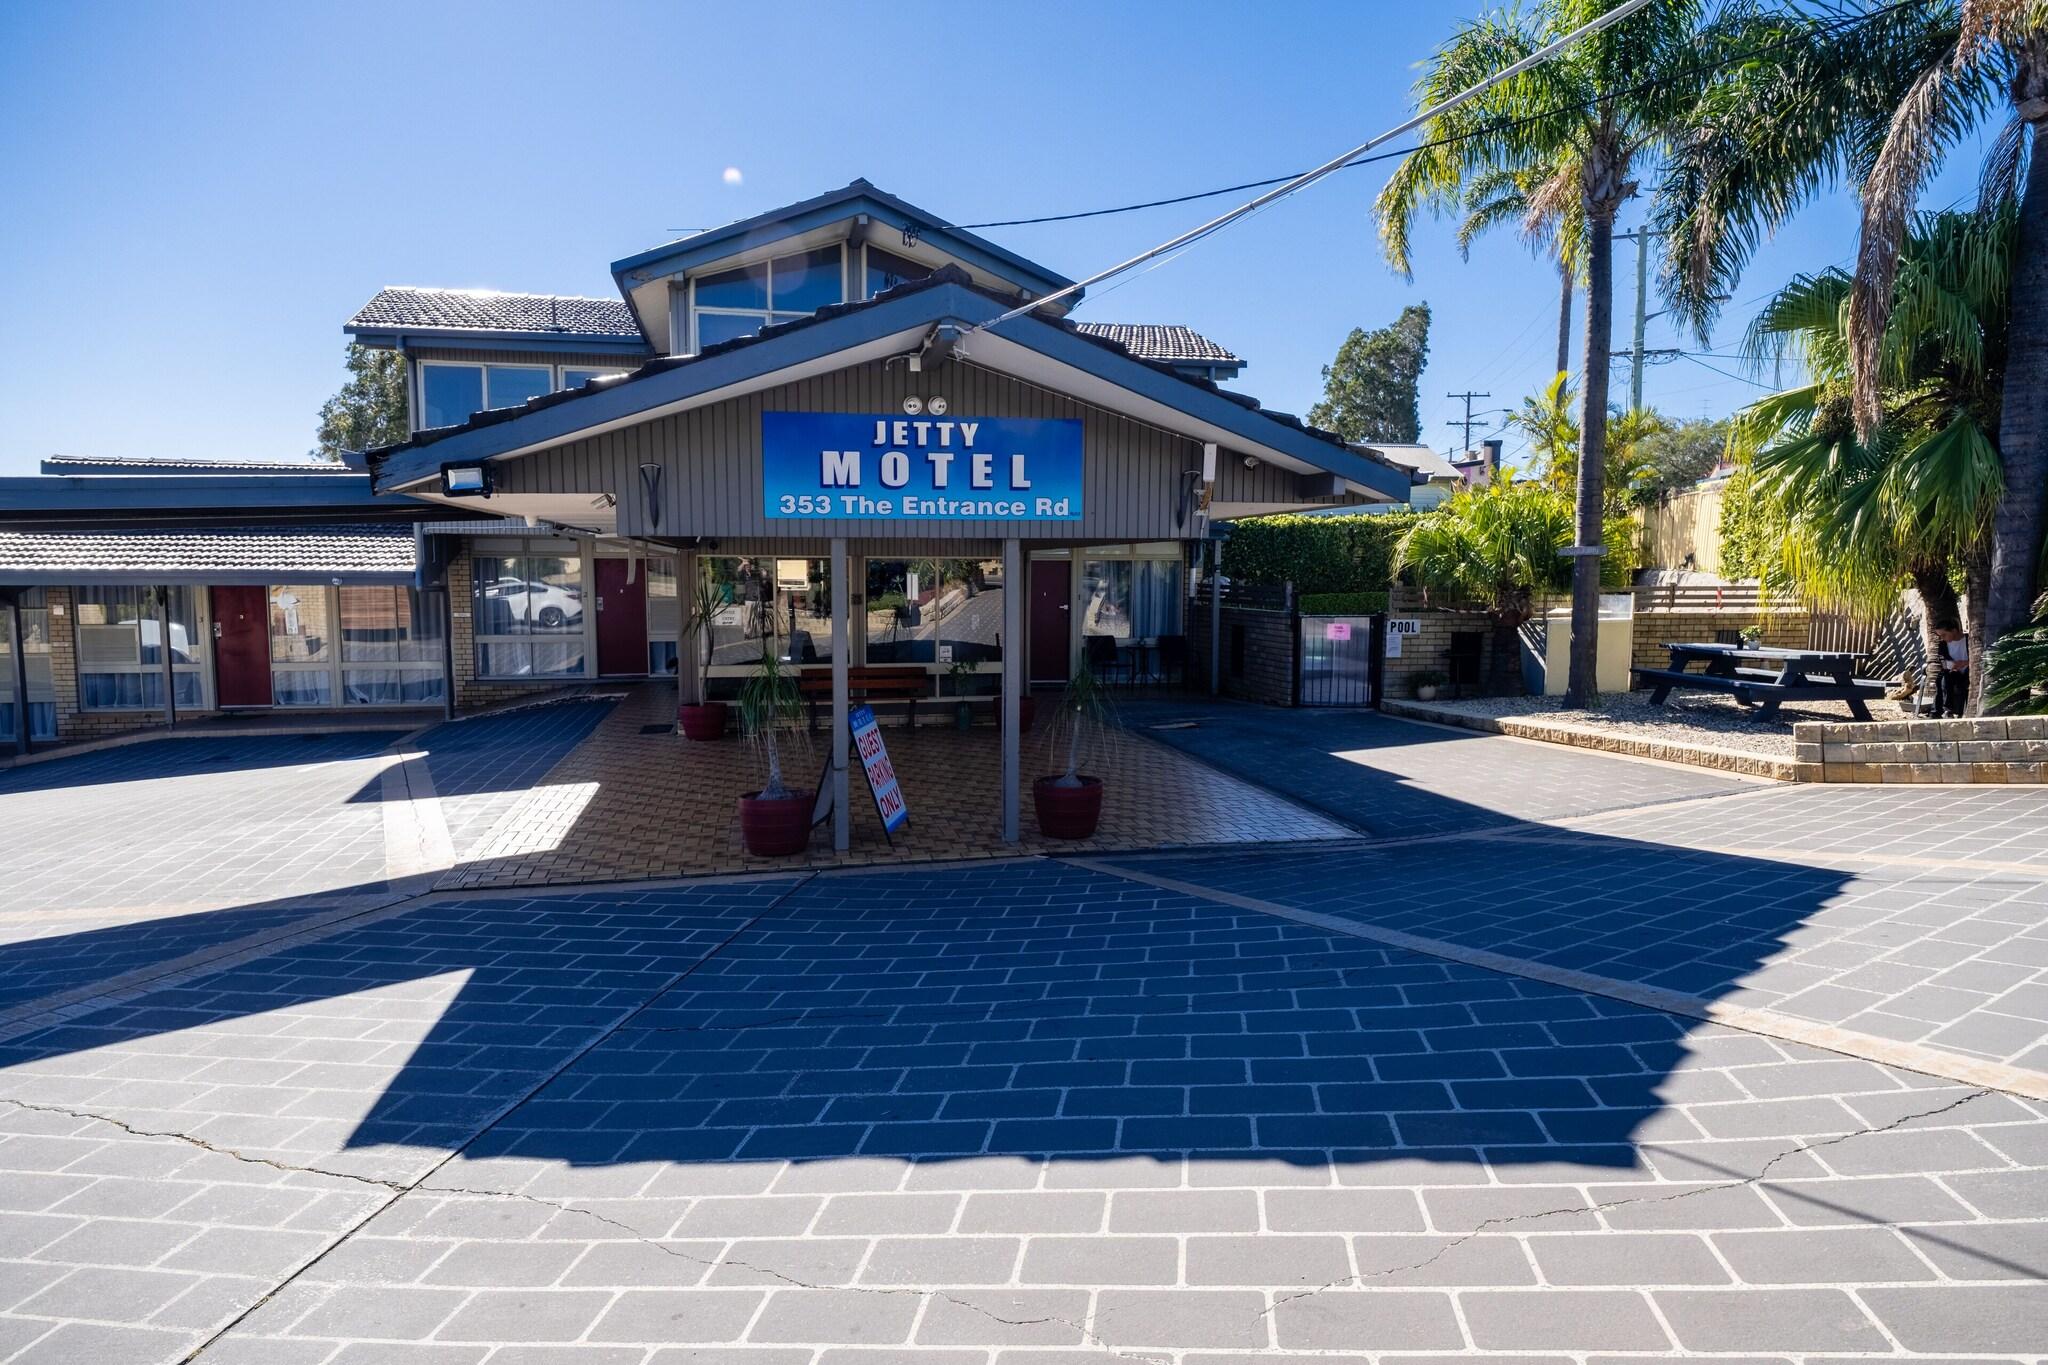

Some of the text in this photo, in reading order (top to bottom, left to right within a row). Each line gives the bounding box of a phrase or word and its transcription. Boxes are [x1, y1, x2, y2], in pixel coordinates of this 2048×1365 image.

[873, 420, 979, 447] JETTY
[821, 450, 1031, 489] MOTEL
[779, 495, 1070, 516] 353 The Entrance Rd
[1390, 621, 1417, 633] POOL
[858, 728, 883, 760] GUEST
[880, 785, 902, 819] ONLY
